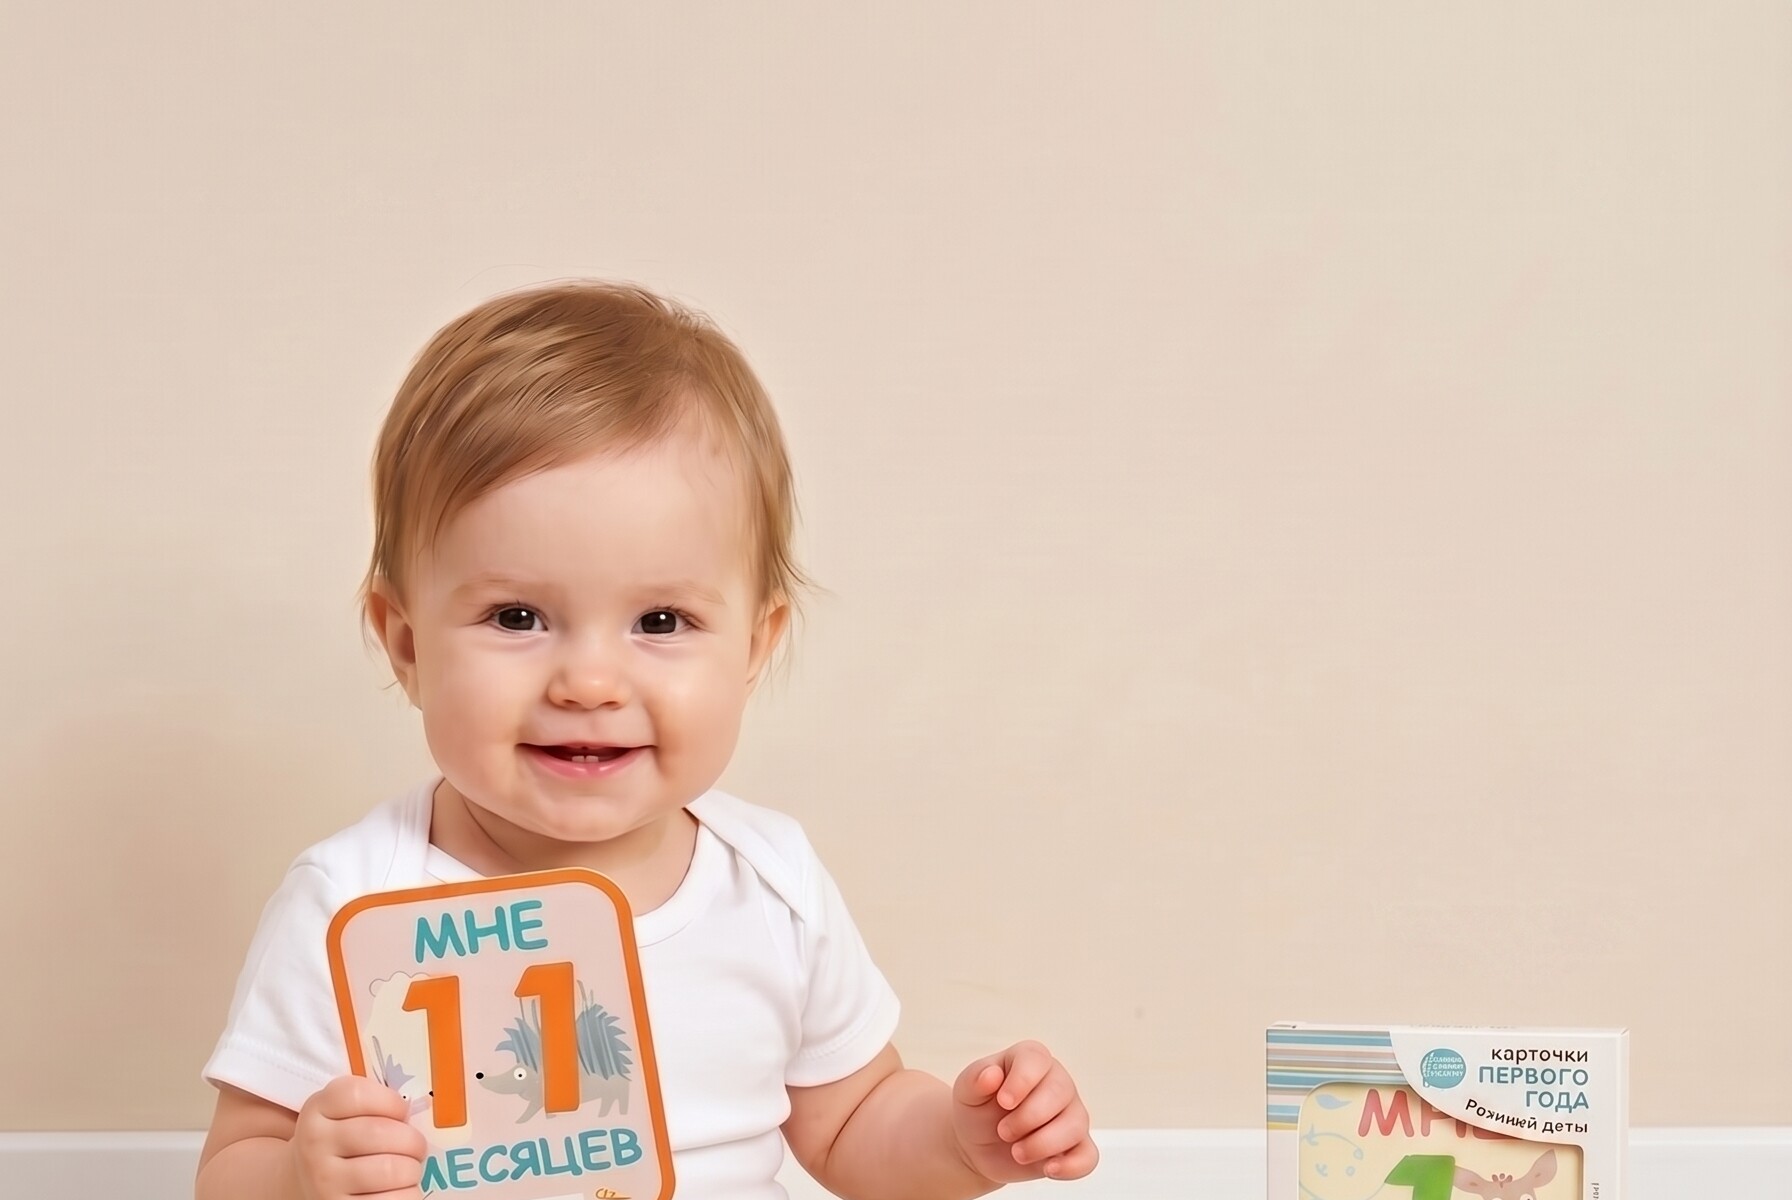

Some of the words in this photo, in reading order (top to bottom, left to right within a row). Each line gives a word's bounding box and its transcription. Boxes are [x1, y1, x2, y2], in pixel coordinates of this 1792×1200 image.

[415, 900, 548, 963] МНЕ
[402, 961, 580, 1129] 11
[1491, 1048, 1588, 1065] карточки
[1478, 1066, 1589, 1086] ПЕРВОГО
[1526, 1090, 1589, 1114] ГОДА
[1541, 1121, 1588, 1134] деты
